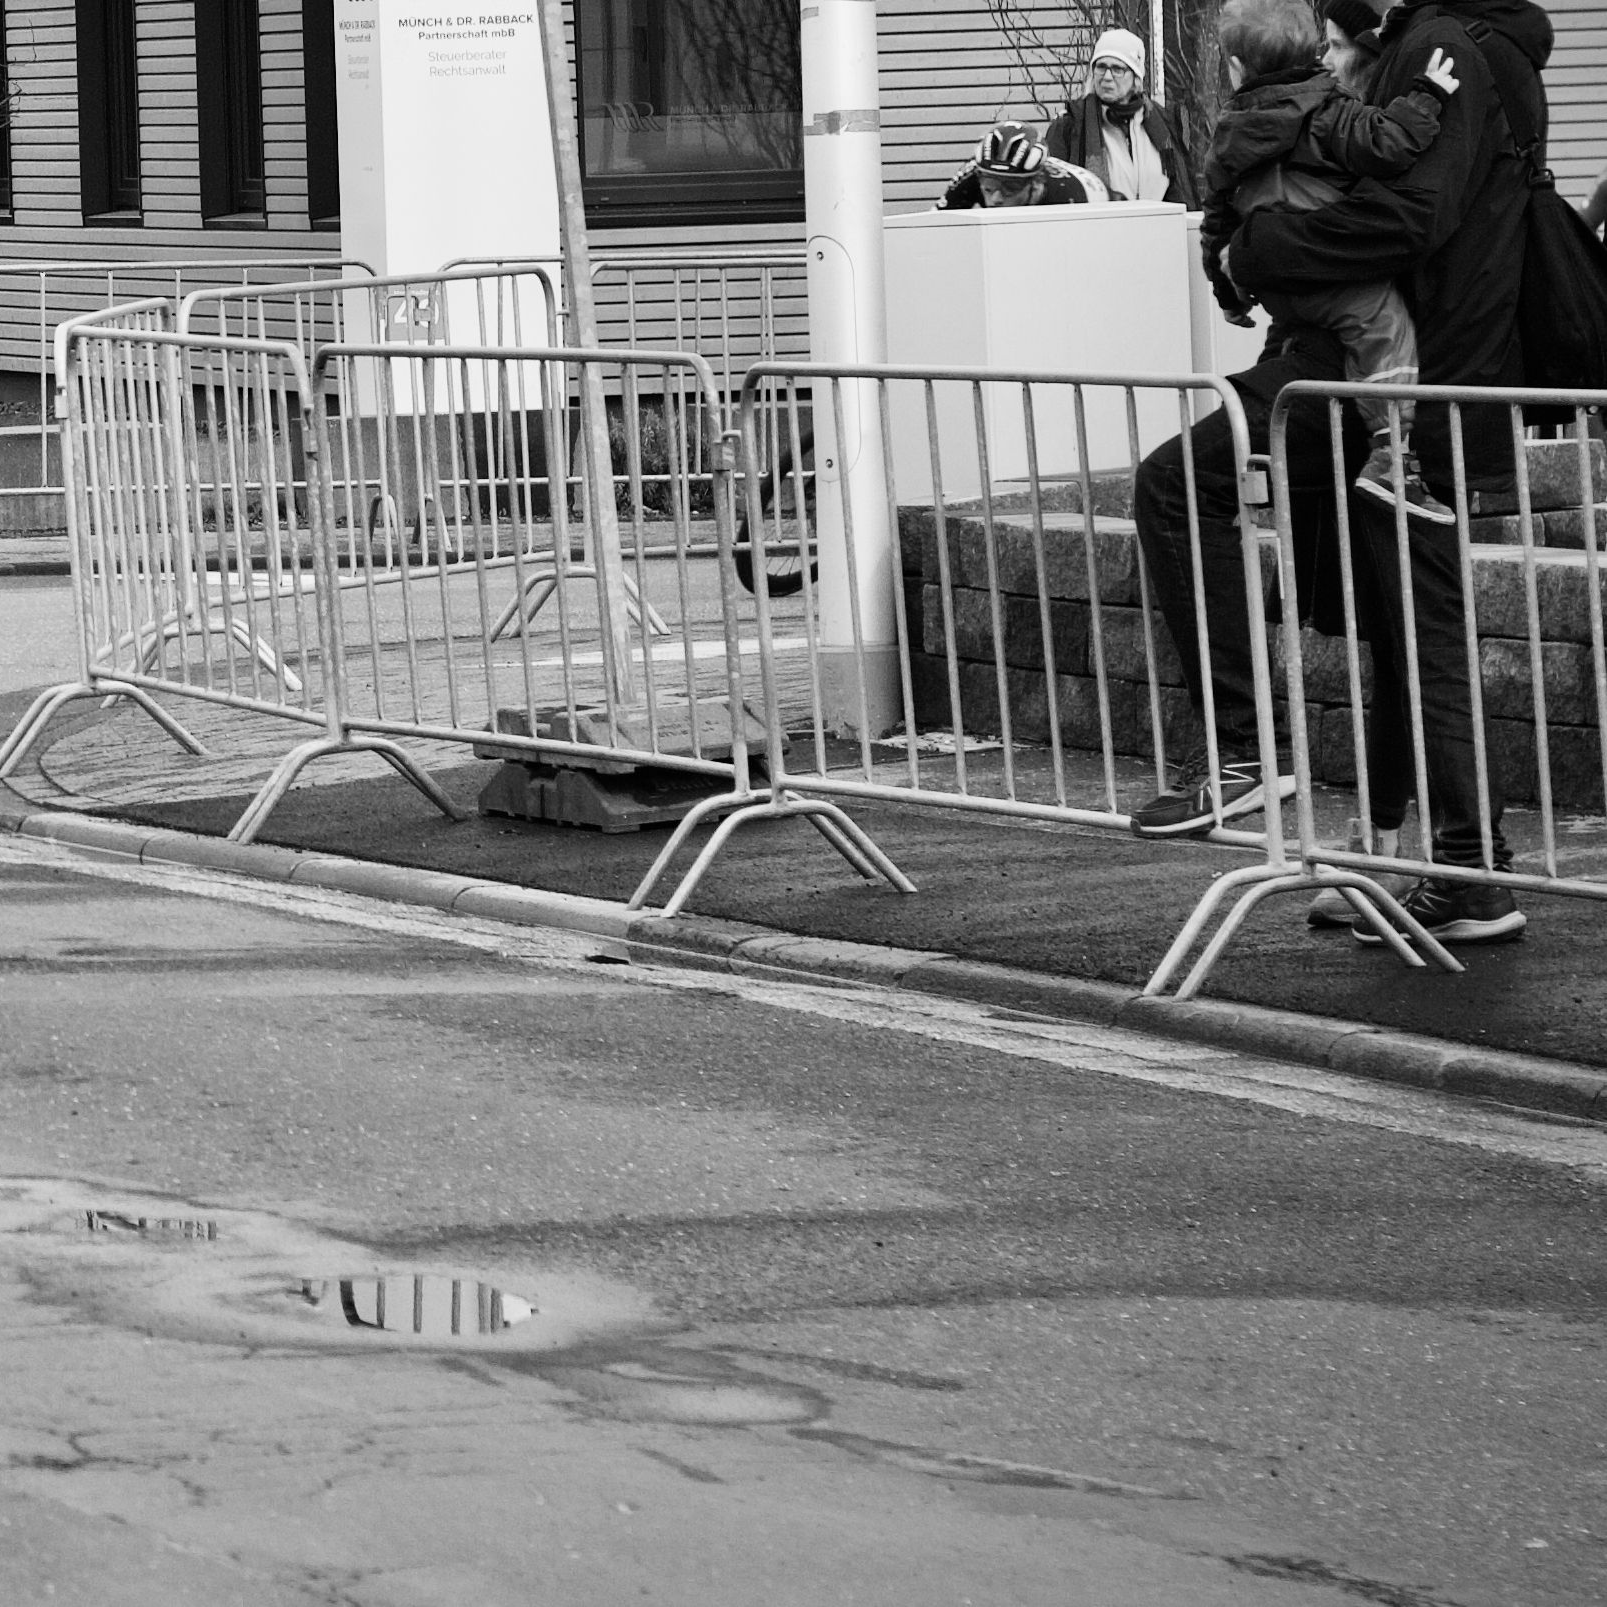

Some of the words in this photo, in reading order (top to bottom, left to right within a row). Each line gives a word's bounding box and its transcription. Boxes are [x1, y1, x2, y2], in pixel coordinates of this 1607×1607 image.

[398, 16, 443, 28] MÜNCH
[445, 16, 453, 27] &
[456, 16, 476, 27] DR.
[478, 14, 535, 26] RABBACK
[418, 29, 488, 41] Partnerschaft
[428, 50, 507, 62] Steuerberater
[429, 64, 506, 77] Rechtsanwalt
